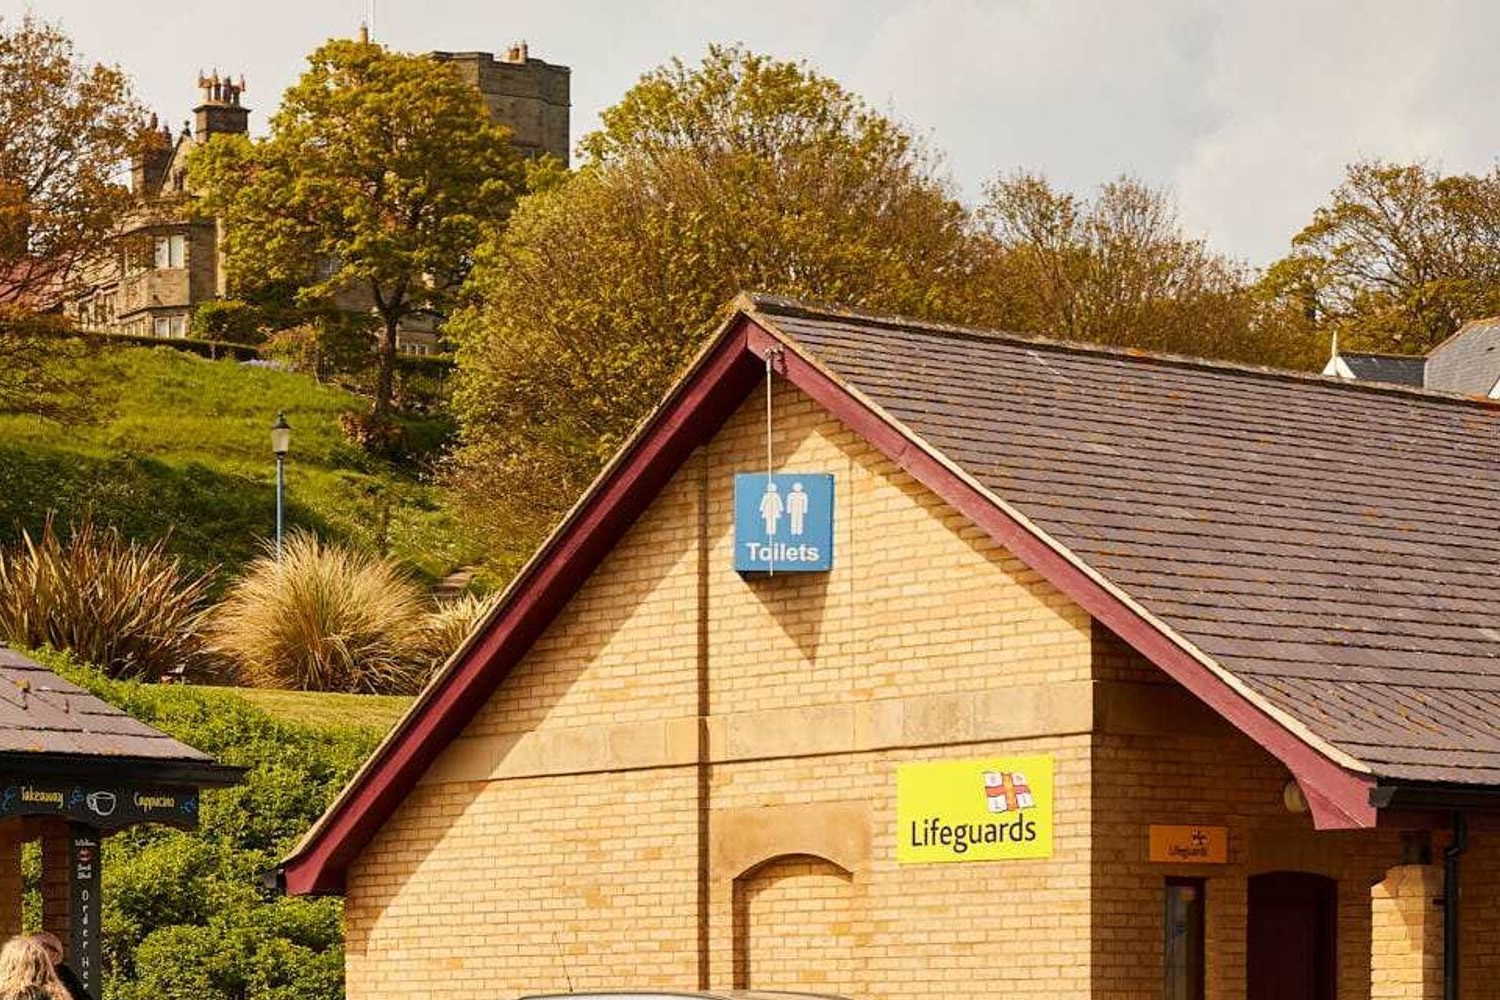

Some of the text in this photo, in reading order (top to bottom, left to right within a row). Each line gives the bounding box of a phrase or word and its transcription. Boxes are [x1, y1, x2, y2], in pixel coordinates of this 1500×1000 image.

[746, 543, 820, 561] Toilets
[21, 791, 64, 809] Takeaway
[911, 814, 1036, 854] Lifeguards
